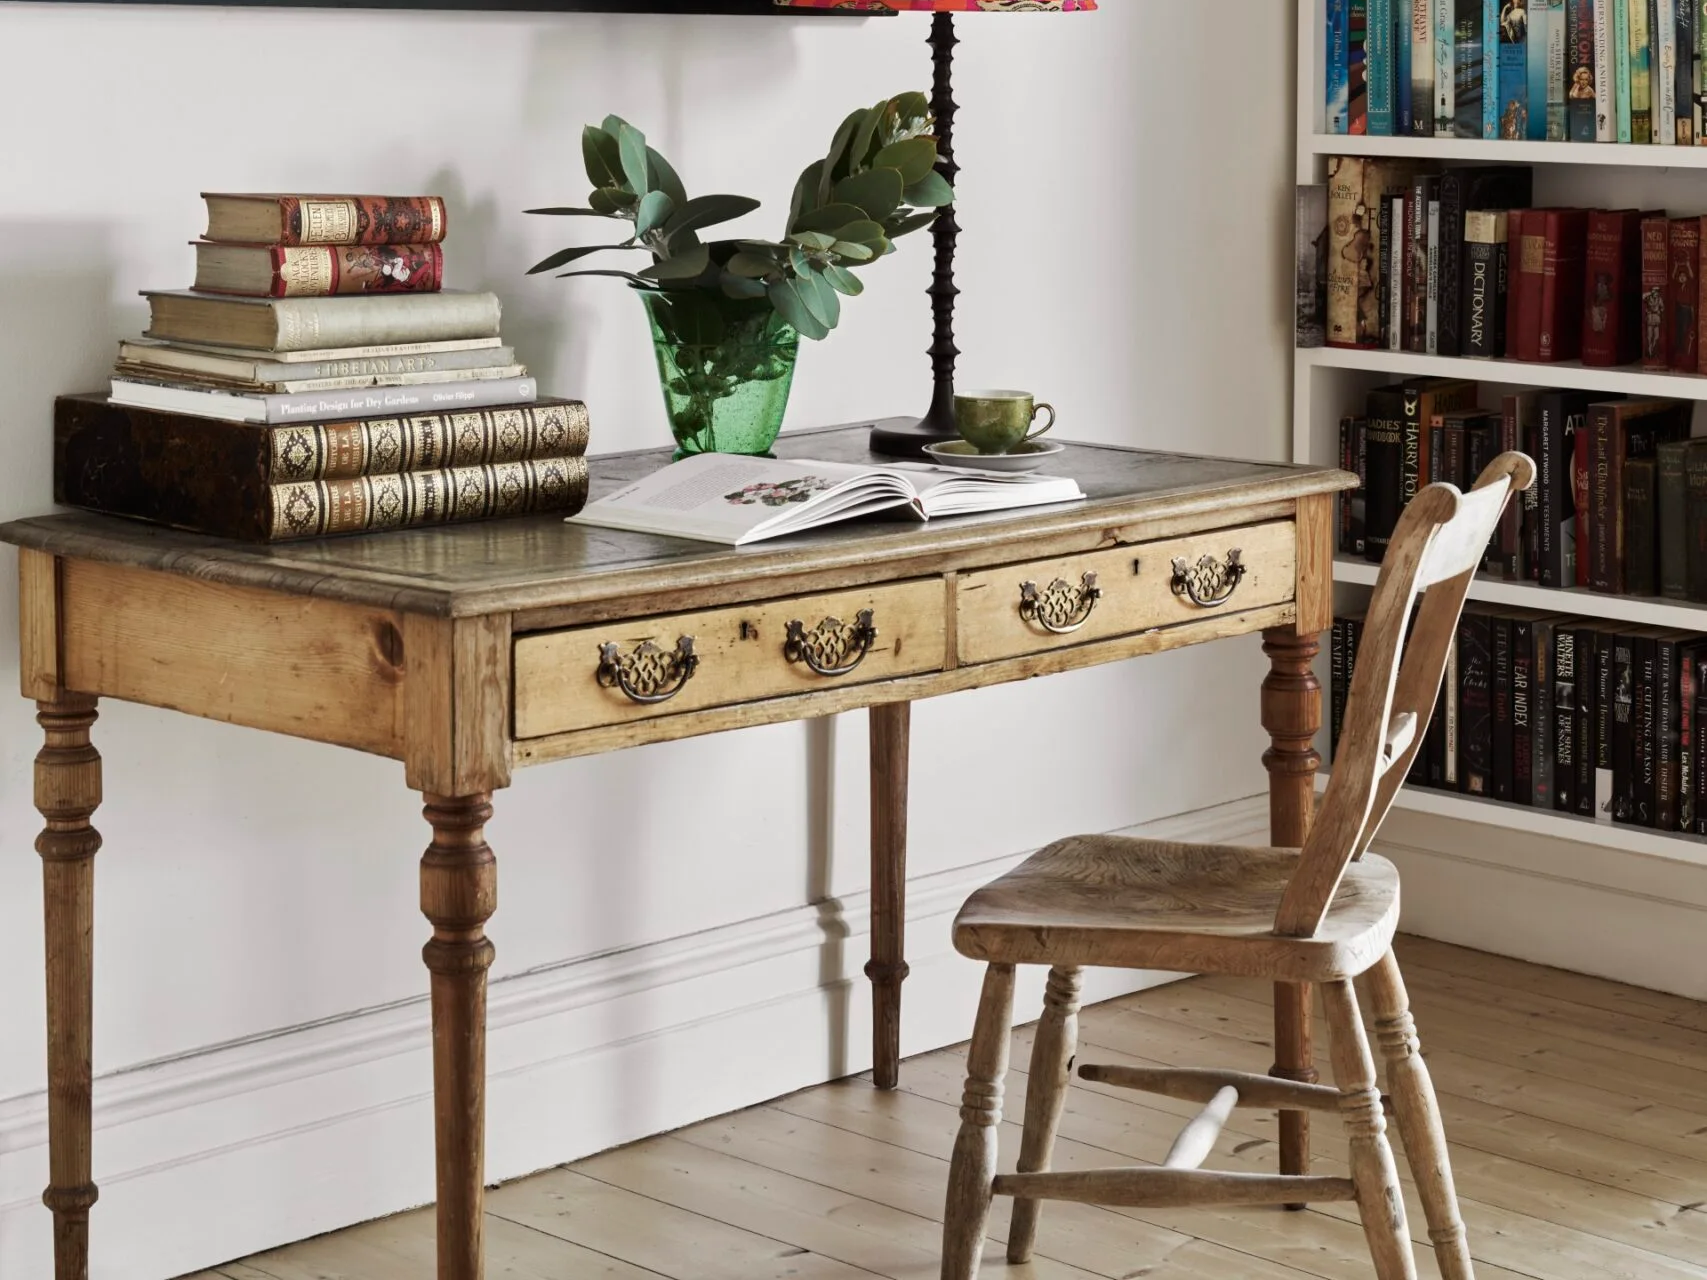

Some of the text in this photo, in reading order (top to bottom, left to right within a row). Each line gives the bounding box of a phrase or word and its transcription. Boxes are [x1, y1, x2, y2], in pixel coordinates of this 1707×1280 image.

[1439, 8, 1447, 32] Grace
[1569, 4, 1578, 45] SHIFTING
[1599, 63, 1607, 103] ANIMALS
[310, 207, 322, 237] ELLEN
[1646, 230, 1663, 241] NED
[291, 259, 301, 285] JACK
[1470, 261, 1487, 348] DICTIONARY
[326, 360, 391, 378] TIBETAN
[280, 394, 420, 417] Planting Design for Dry Gardens
[432, 391, 475, 405] Olivier Filippi
[341, 435, 350, 452] LA
[350, 425, 361, 472] MUSIQUE
[1404, 421, 1421, 471] HARRY
[1541, 409, 1549, 451] MARGARET
[1542, 452, 1550, 485] ATWOOD
[1596, 416, 1609, 520] The Last Witchfinder
[344, 490, 353, 522] DE LA
[1543, 504, 1551, 552] TESTAMENTS
[1497, 631, 1507, 685] TEMPLE
[1556, 634, 1566, 679] WALTERS
[1564, 633, 1574, 678] MINETTE
[1600, 649, 1609, 700] The Dinner
[1661, 646, 1670, 679] BITTER
[1513, 658, 1530, 728] FEAR INDEX
[1558, 713, 1566, 764] OF SNAKES
[1565, 713, 1573, 766] THE SHAPE
[1599, 703, 1608, 766] Herman Koch
[1643, 659, 1653, 785] THE CUTTING SEASON
[1661, 706, 1669, 732] ROAD
[1660, 735, 1669, 764] GARRY
[1680, 751, 1690, 795] Lex McAulay
